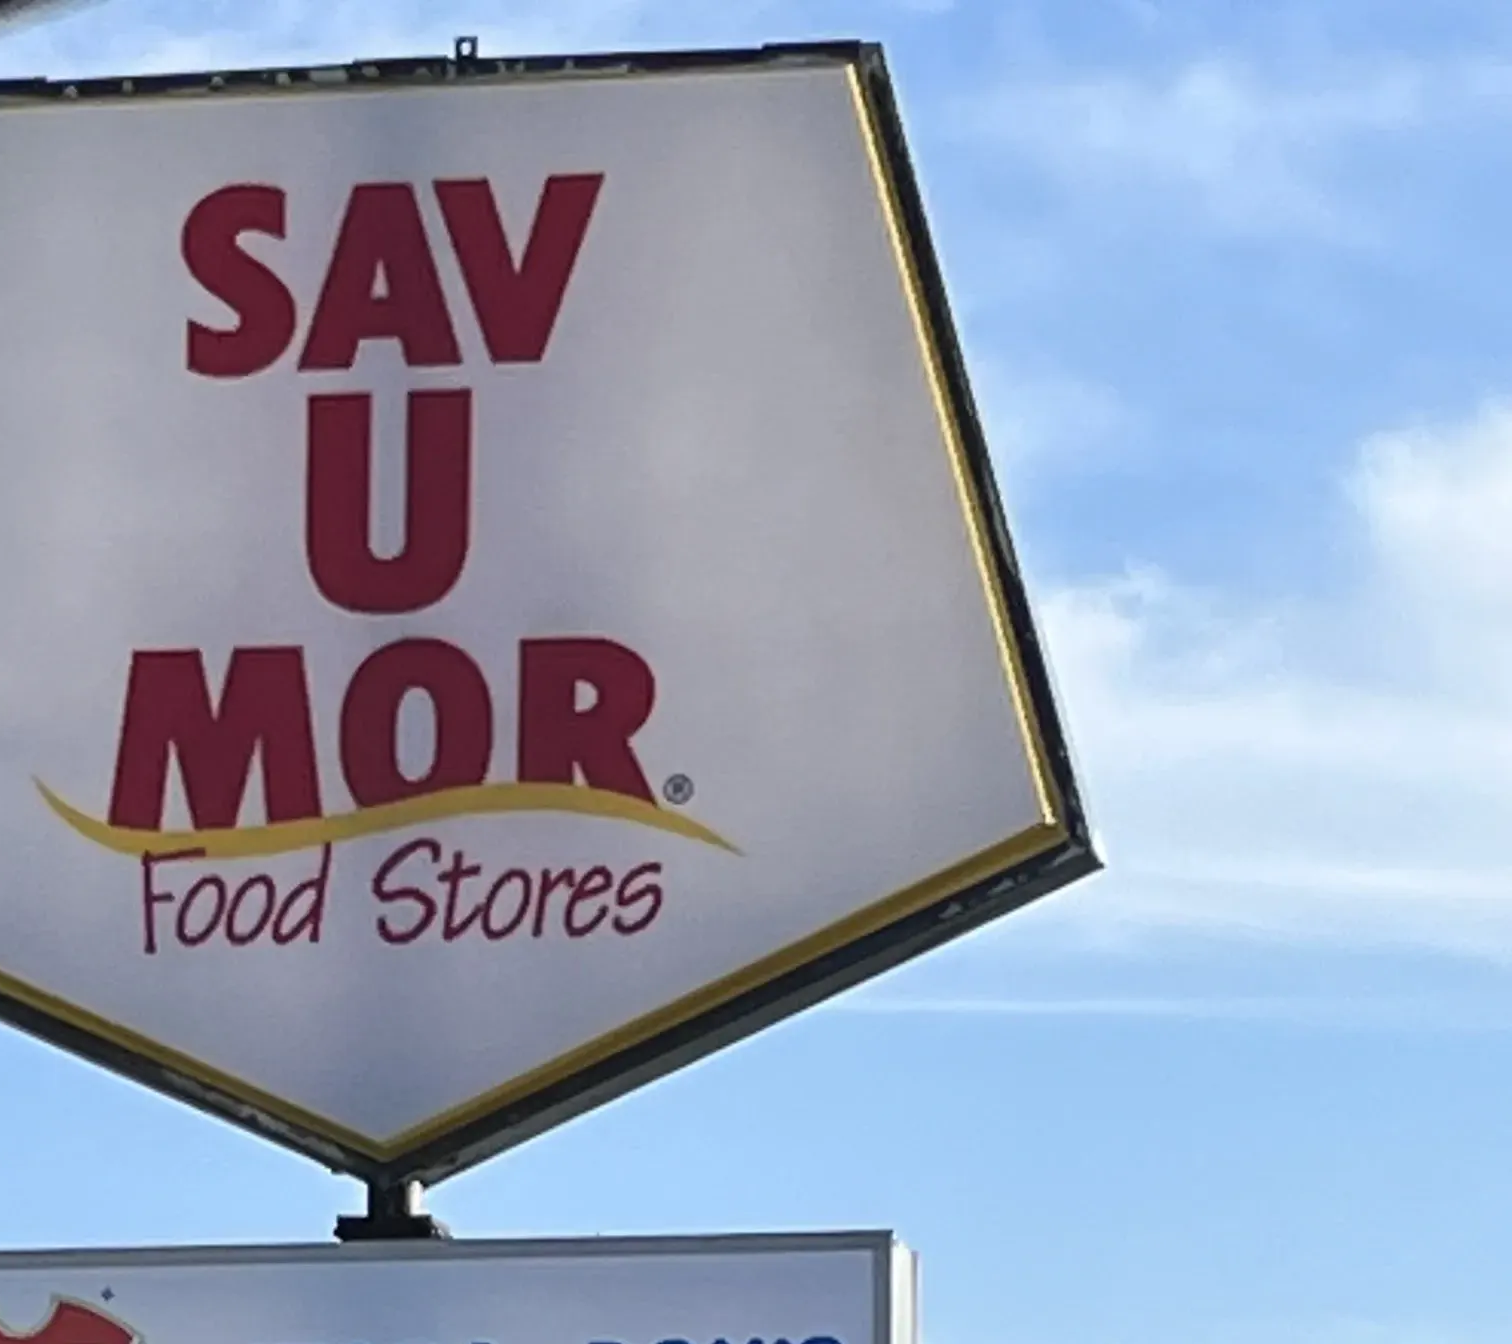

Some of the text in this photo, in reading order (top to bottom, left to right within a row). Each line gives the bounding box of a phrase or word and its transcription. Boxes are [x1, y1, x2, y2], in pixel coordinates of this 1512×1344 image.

[181, 172, 606, 379] SAV
[305, 387, 473, 615] U
[108, 637, 658, 832] MOR
[142, 838, 663, 954] Food Stores
